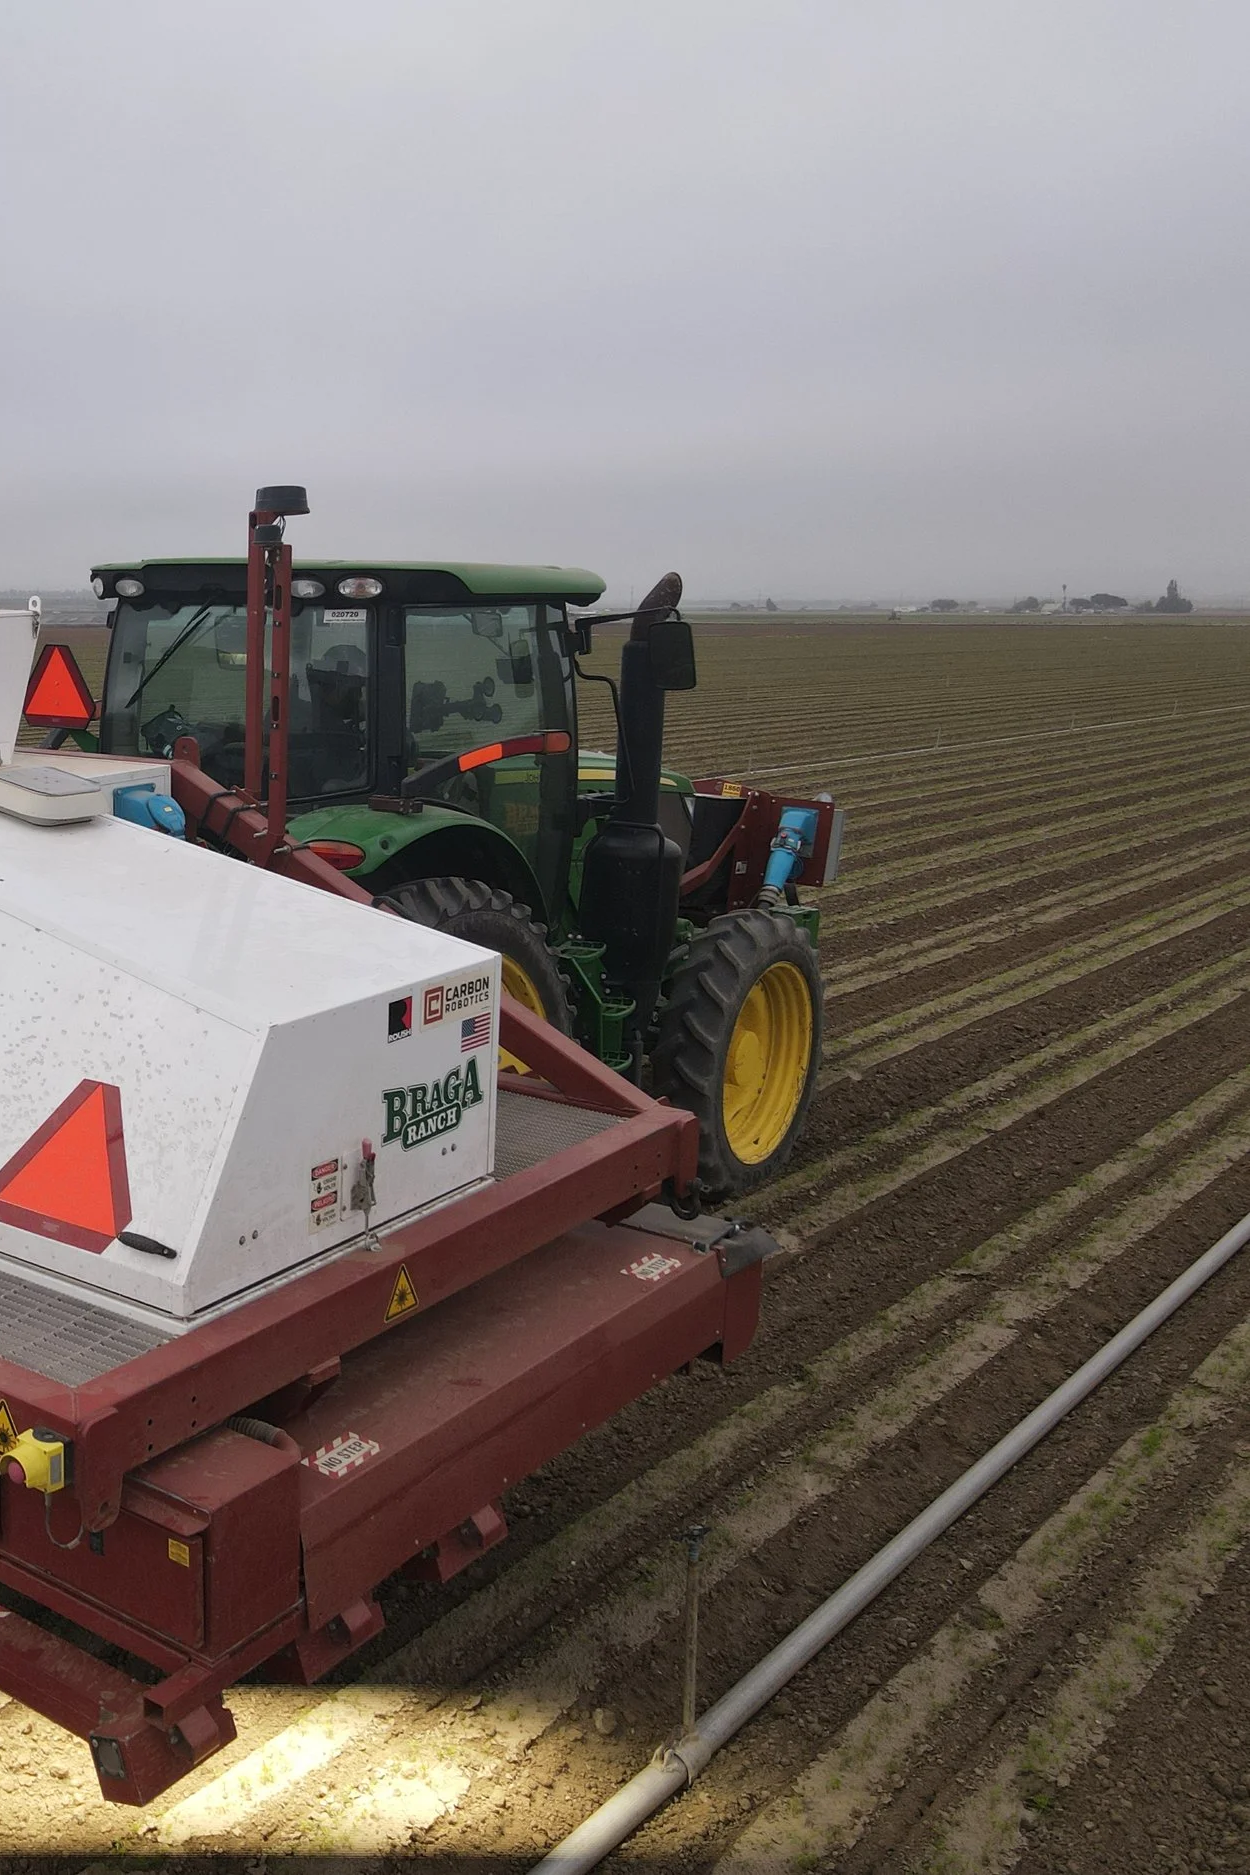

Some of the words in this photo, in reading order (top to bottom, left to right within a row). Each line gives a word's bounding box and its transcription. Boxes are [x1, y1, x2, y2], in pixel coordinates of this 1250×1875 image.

[445, 976, 490, 1002] CARBON
[445, 990, 490, 1013] ROBOTICS
[381, 1056, 483, 1147] BRAGA
[406, 1106, 458, 1145] RANCH
[321, 1456, 343, 1470] NO
[336, 1440, 366, 1460] STEP
